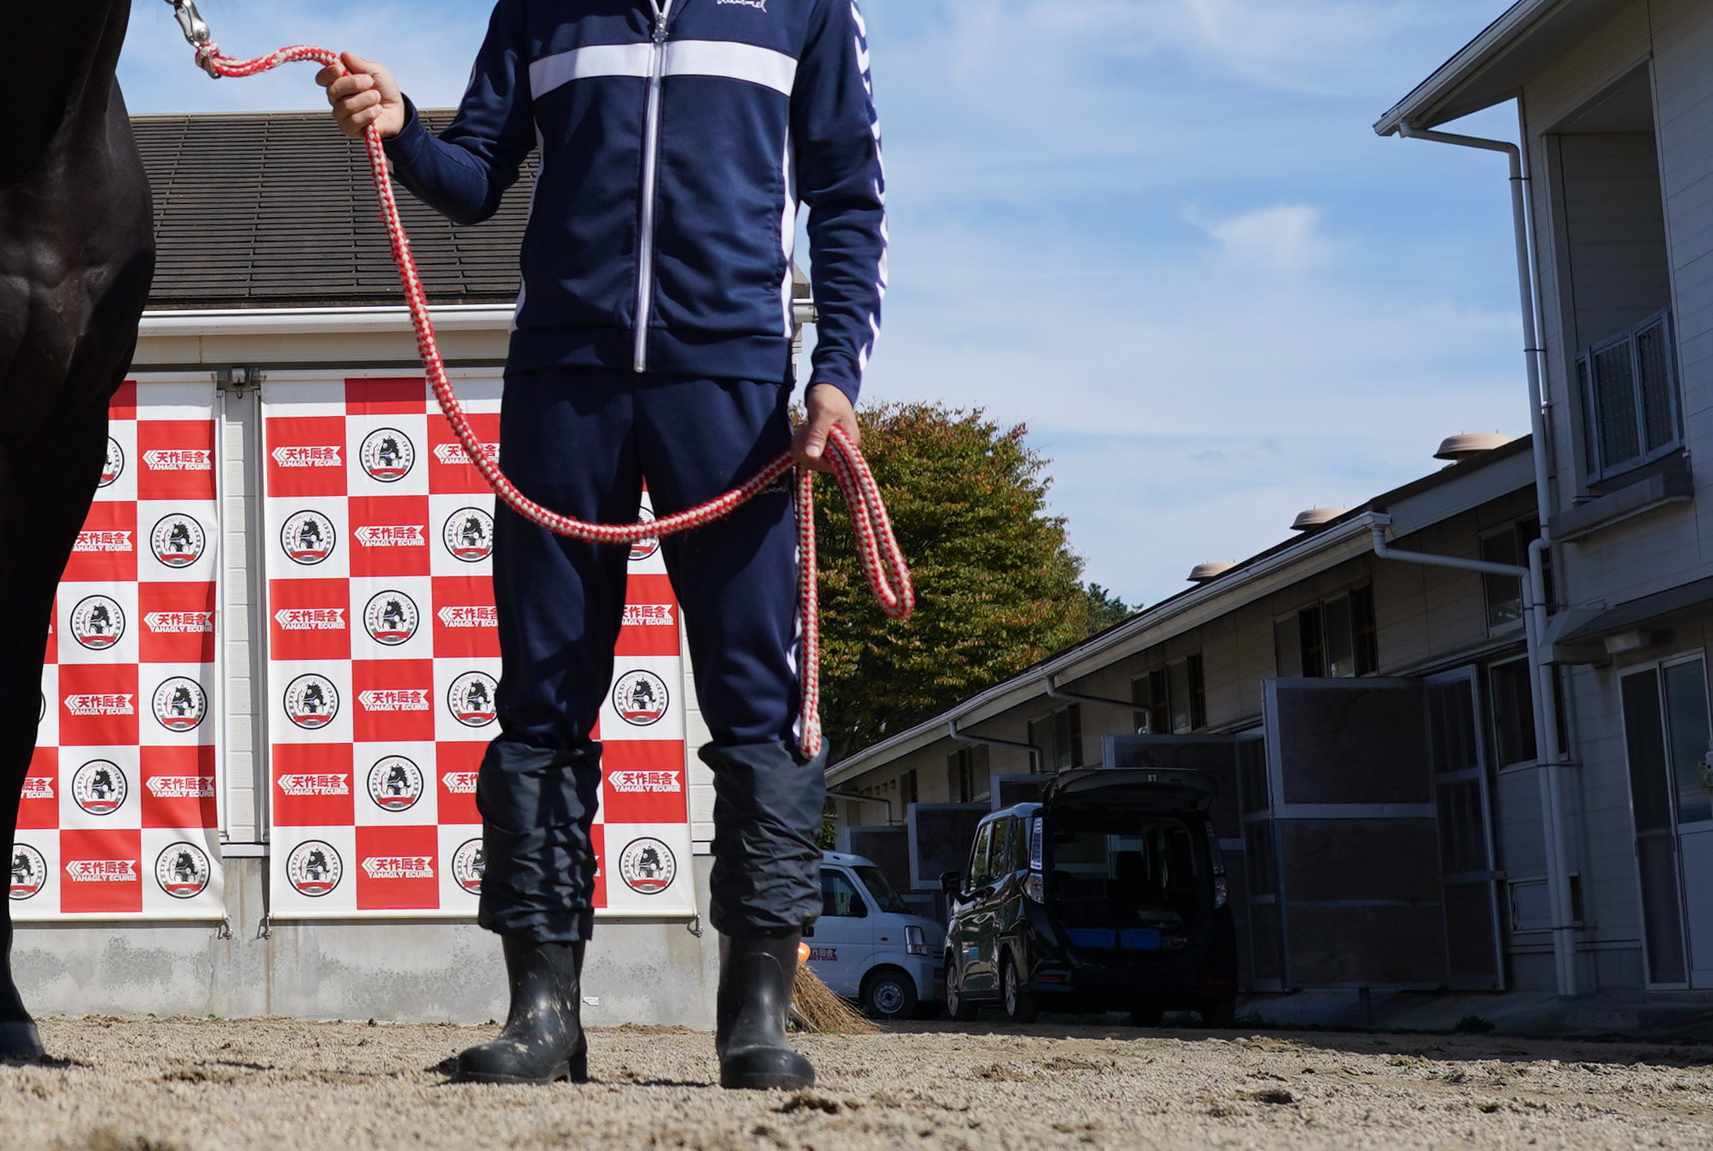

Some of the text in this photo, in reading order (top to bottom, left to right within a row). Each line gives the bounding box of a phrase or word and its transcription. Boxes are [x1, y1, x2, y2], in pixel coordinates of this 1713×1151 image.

[185, 462, 214, 470] ECURIE
[314, 459, 342, 467] ECURIE
[397, 538, 426, 546] ECURIE
[186, 625, 214, 633] ECURIE
[317, 622, 346, 630] ECURIE
[106, 707, 134, 715] ECURIE
[401, 703, 430, 711] ECURIE
[321, 787, 350, 795] ECURIE
[652, 784, 680, 792] ECURIE
[188, 789, 216, 797] ECURIE
[108, 873, 136, 881] ECURIE
[405, 870, 434, 878] ECURIE
